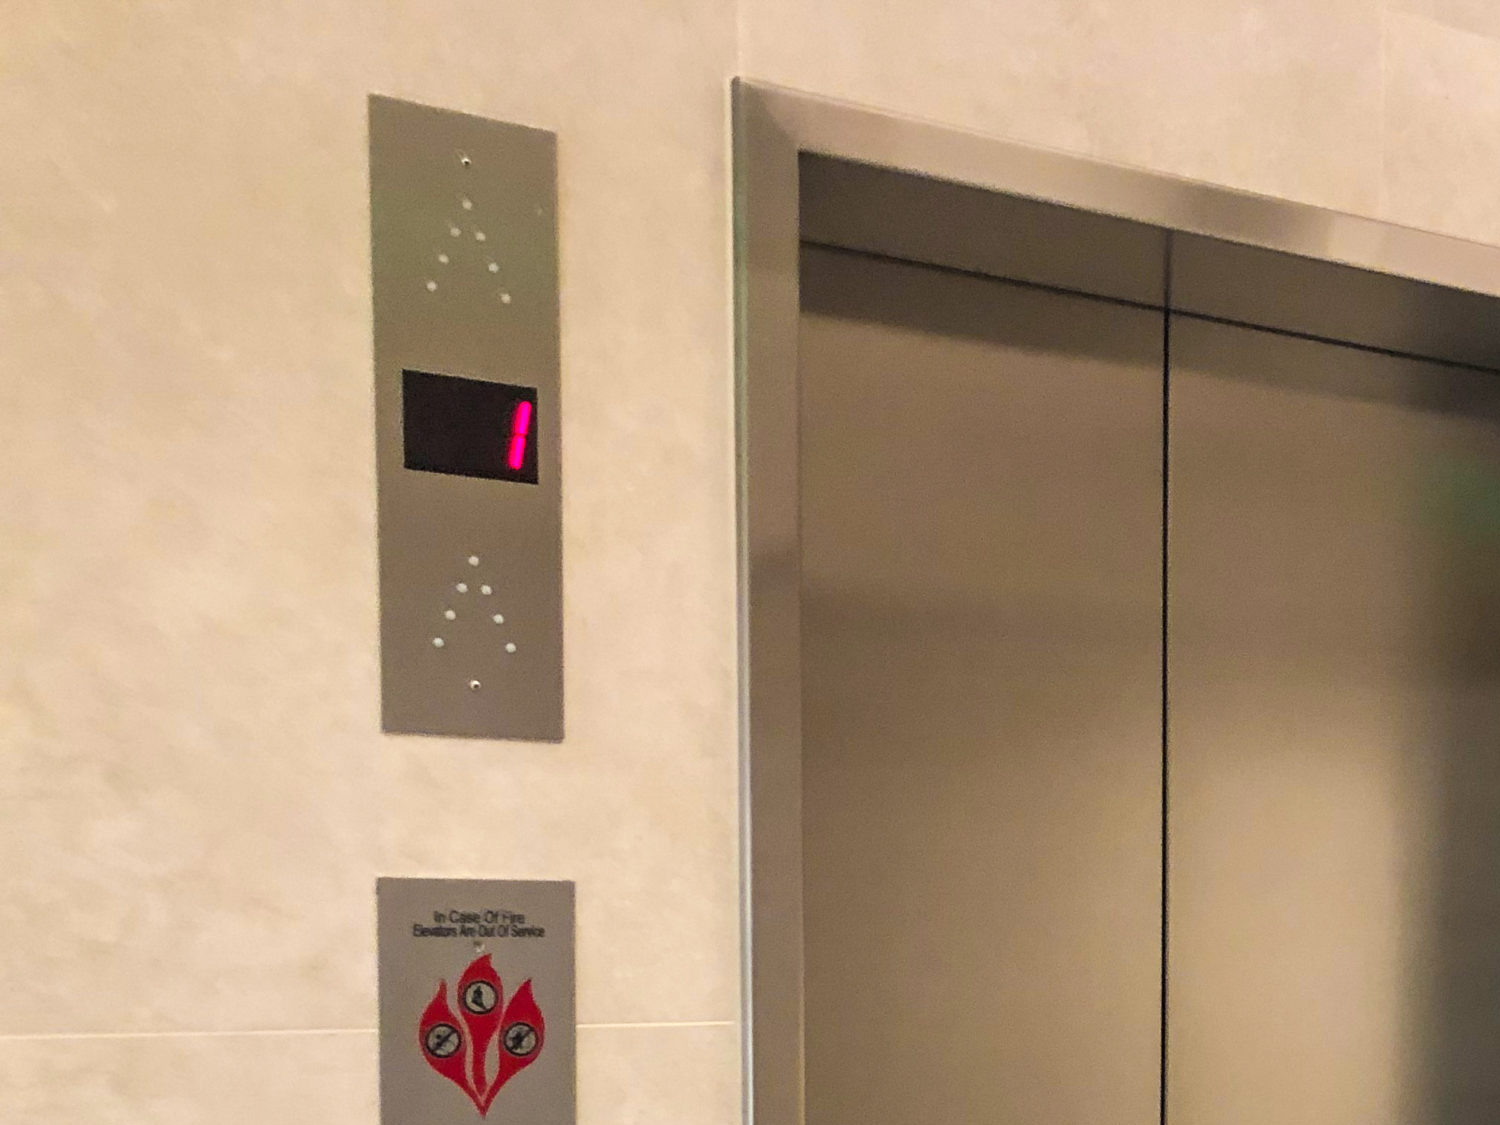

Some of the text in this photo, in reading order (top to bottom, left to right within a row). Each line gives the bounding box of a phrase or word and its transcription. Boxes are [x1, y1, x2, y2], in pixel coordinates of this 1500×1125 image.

[433, 910, 525, 924] In Case Of Fire
[412, 924, 545, 938] Elevators Are Out Of Service
